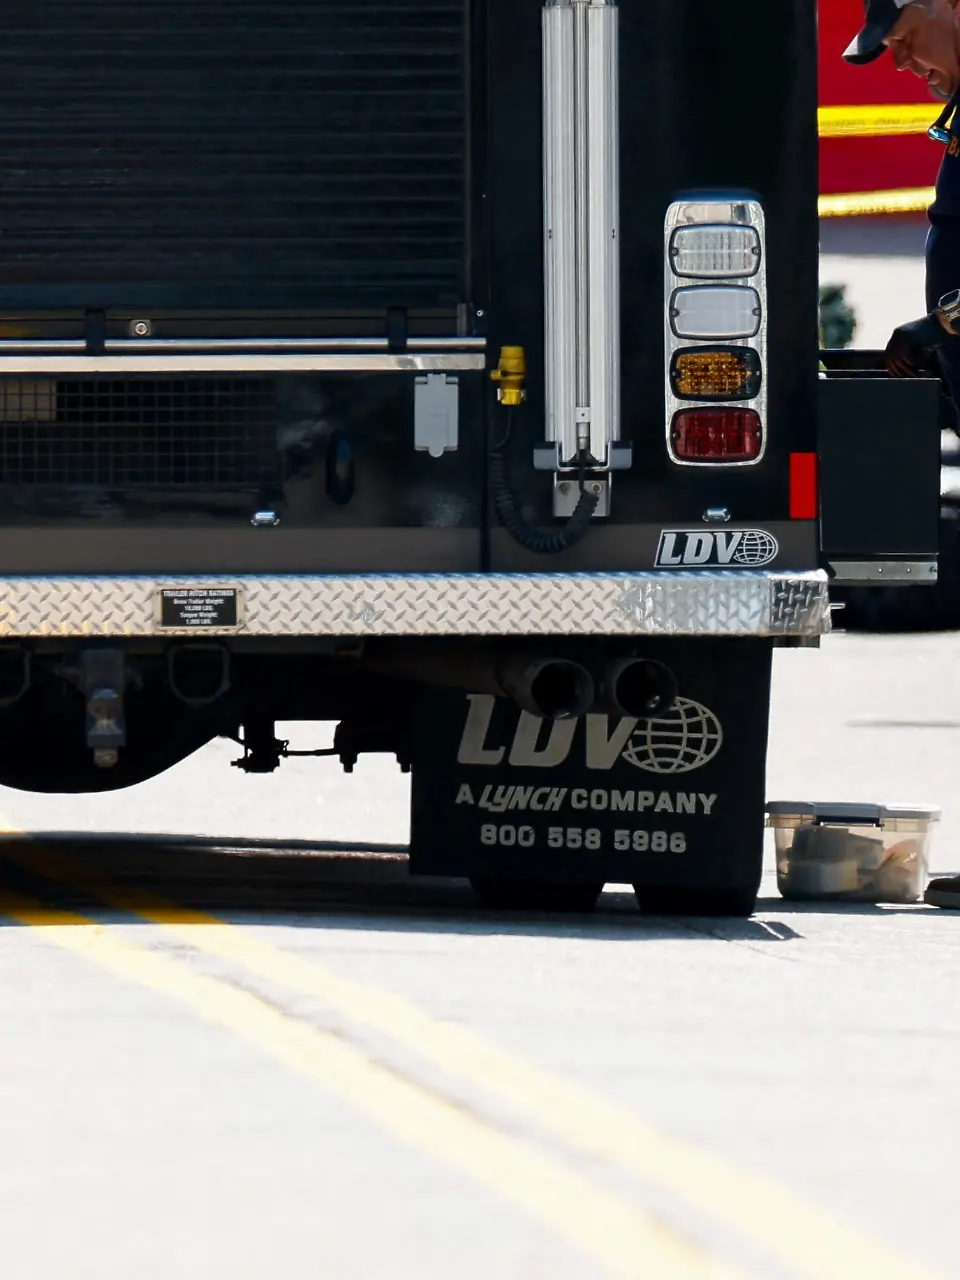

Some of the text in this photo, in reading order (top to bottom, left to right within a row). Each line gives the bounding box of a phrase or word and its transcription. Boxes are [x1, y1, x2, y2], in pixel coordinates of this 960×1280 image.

[659, 531, 742, 565] LDV
[457, 694, 640, 770] LDV
[455, 783, 718, 815] A LYNCH COMPANY
[480, 824, 535, 847] 800
[547, 826, 601, 850] 558
